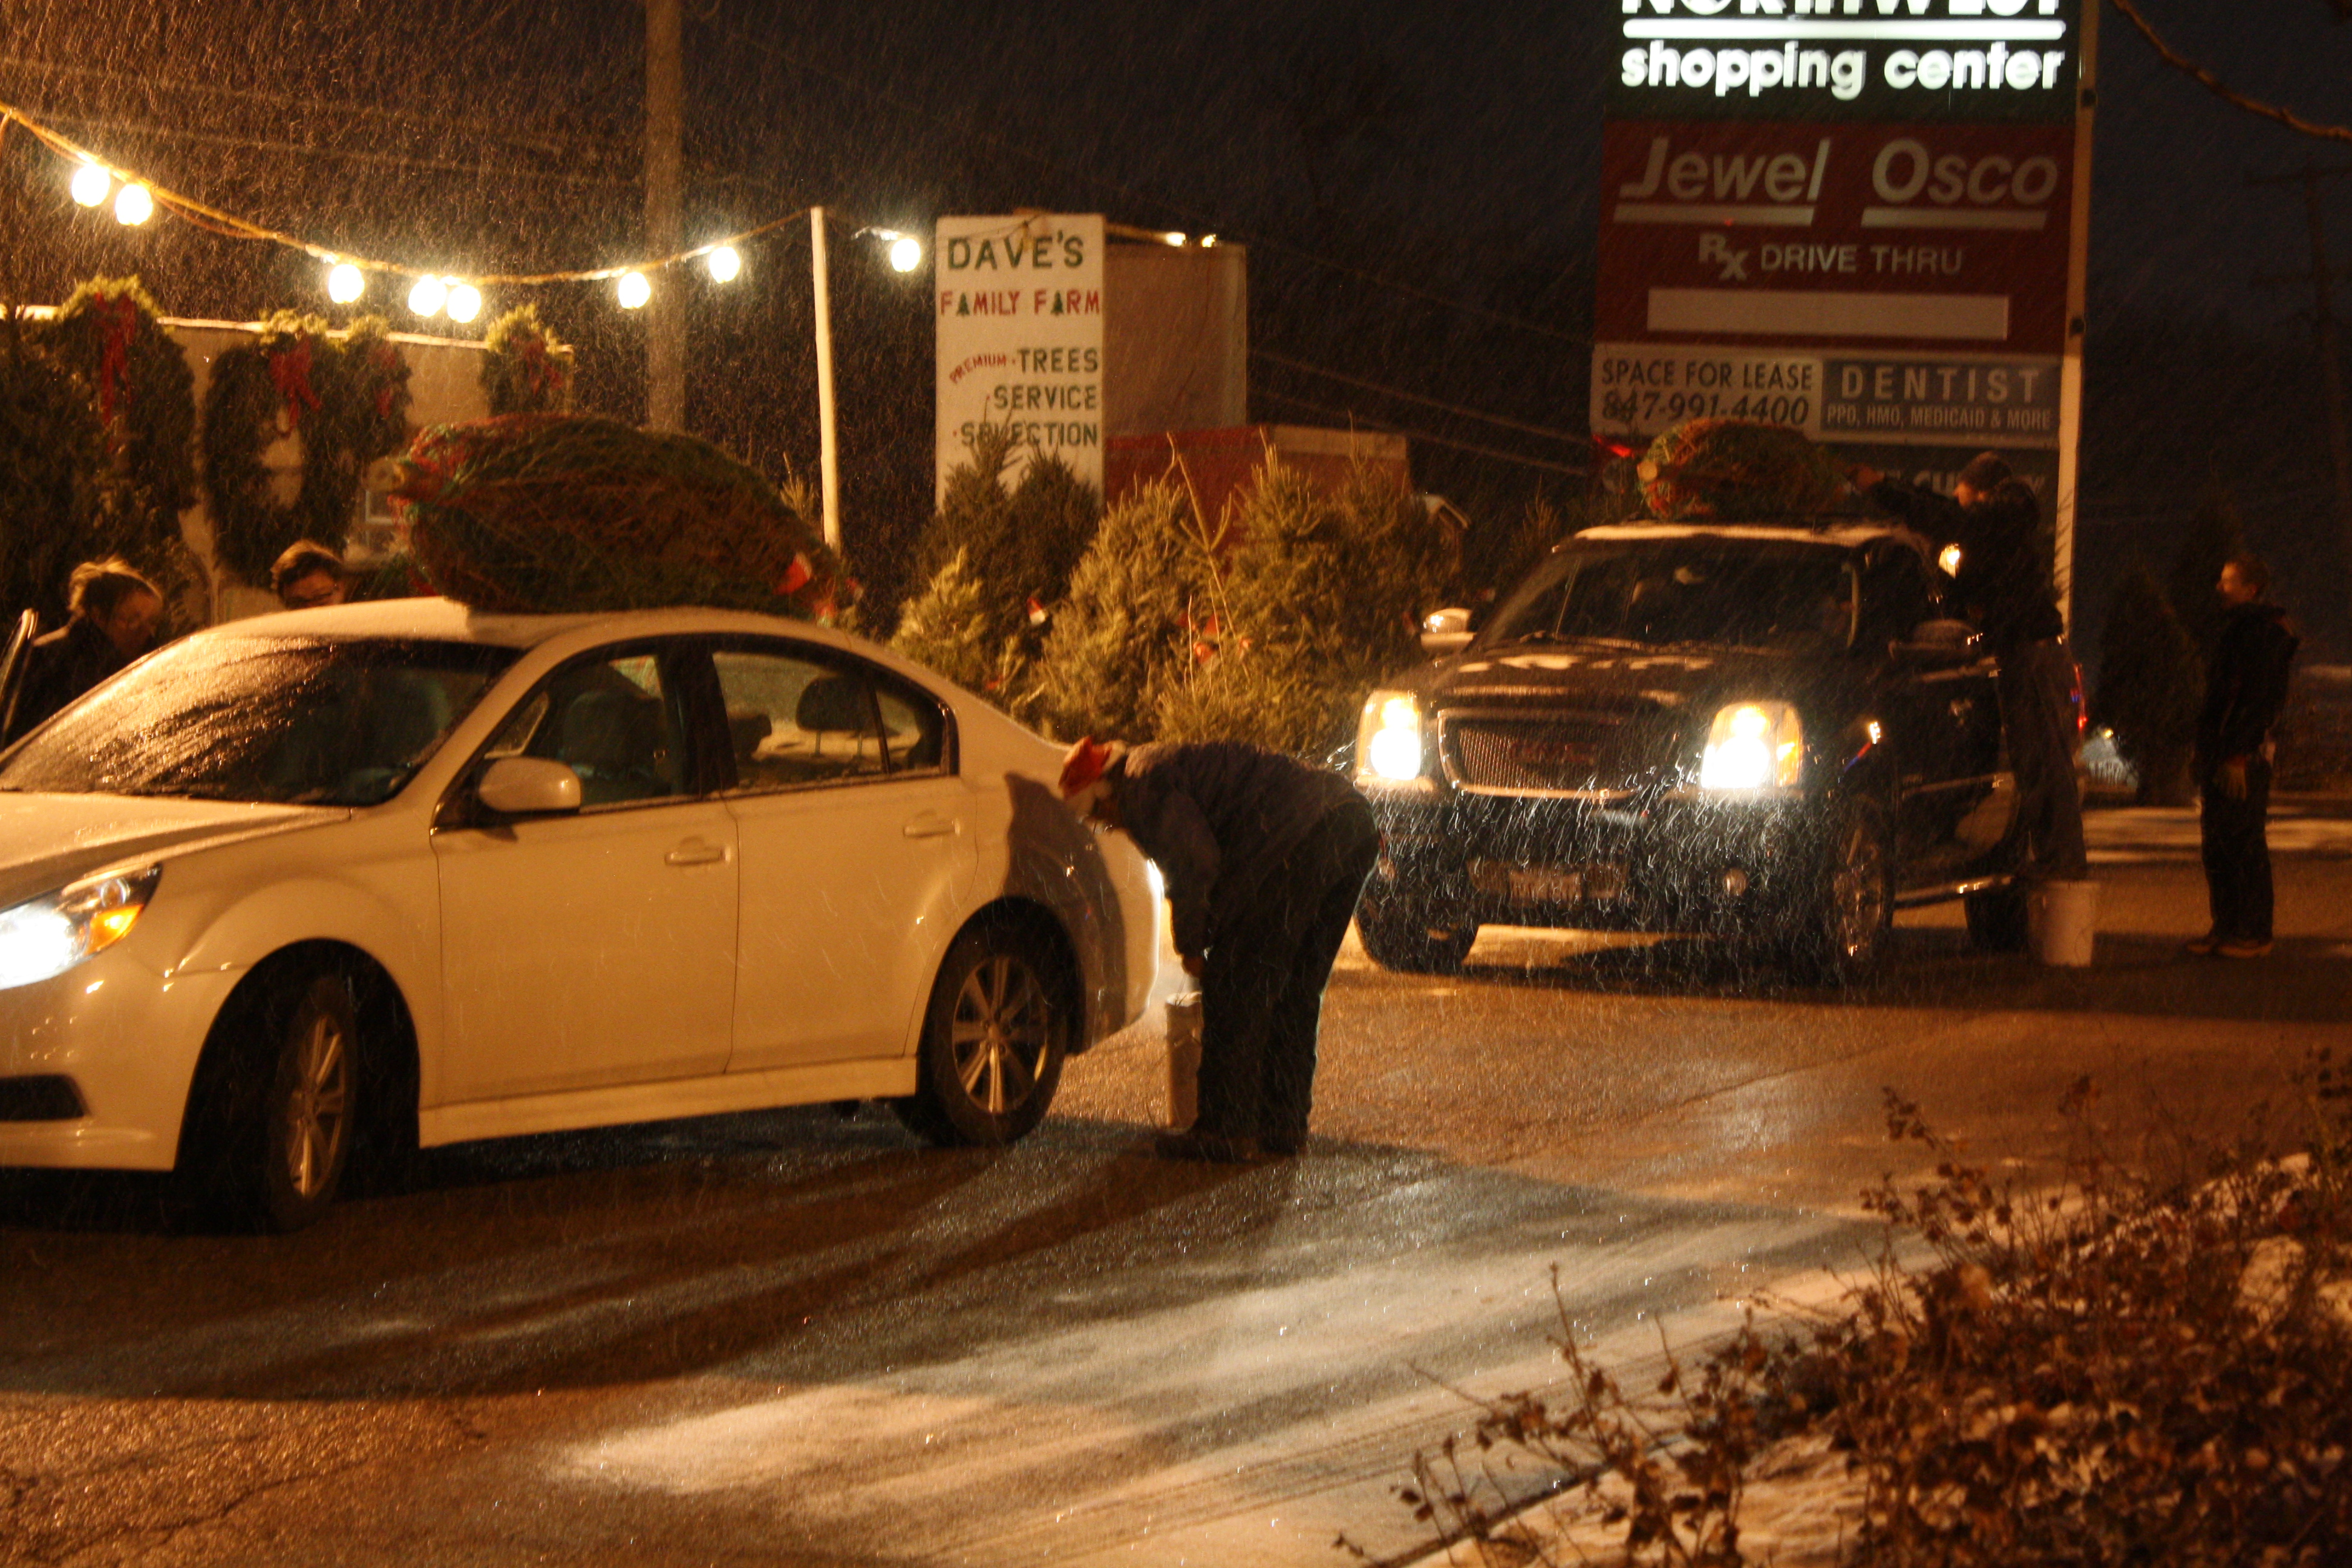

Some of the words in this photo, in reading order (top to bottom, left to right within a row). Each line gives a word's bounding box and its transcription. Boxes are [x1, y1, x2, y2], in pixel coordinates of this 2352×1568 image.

[1621, 41, 1866, 100] shopping
[1884, 41, 2065, 90] center
[1619, 137, 1831, 201] Jewel
[1872, 137, 2057, 203] Osco
[947, 230, 1084, 269] DAVE'S
[1761, 246, 1857, 273] DRIVE
[1870, 247, 1963, 275] THRU
[941, 290, 1021, 316] FAMILY
[1034, 289, 1100, 316] FARM
[949, 354, 1007, 384] PREMIUM
[1017, 348, 1098, 374] TREES
[1602, 358, 1674, 385] SPACE
[1686, 361, 1732, 388] FOR
[1743, 363, 1812, 391] LEASE
[993, 384, 1097, 410] SERVICE
[1841, 365, 2040, 403] DENTIST
[1602, 390, 1809, 425] 847-991-4400
[1910, 407, 1985, 429] MEDICAID
[1990, 410, 2001, 428] &
[2007, 410, 2051, 430] MORE
